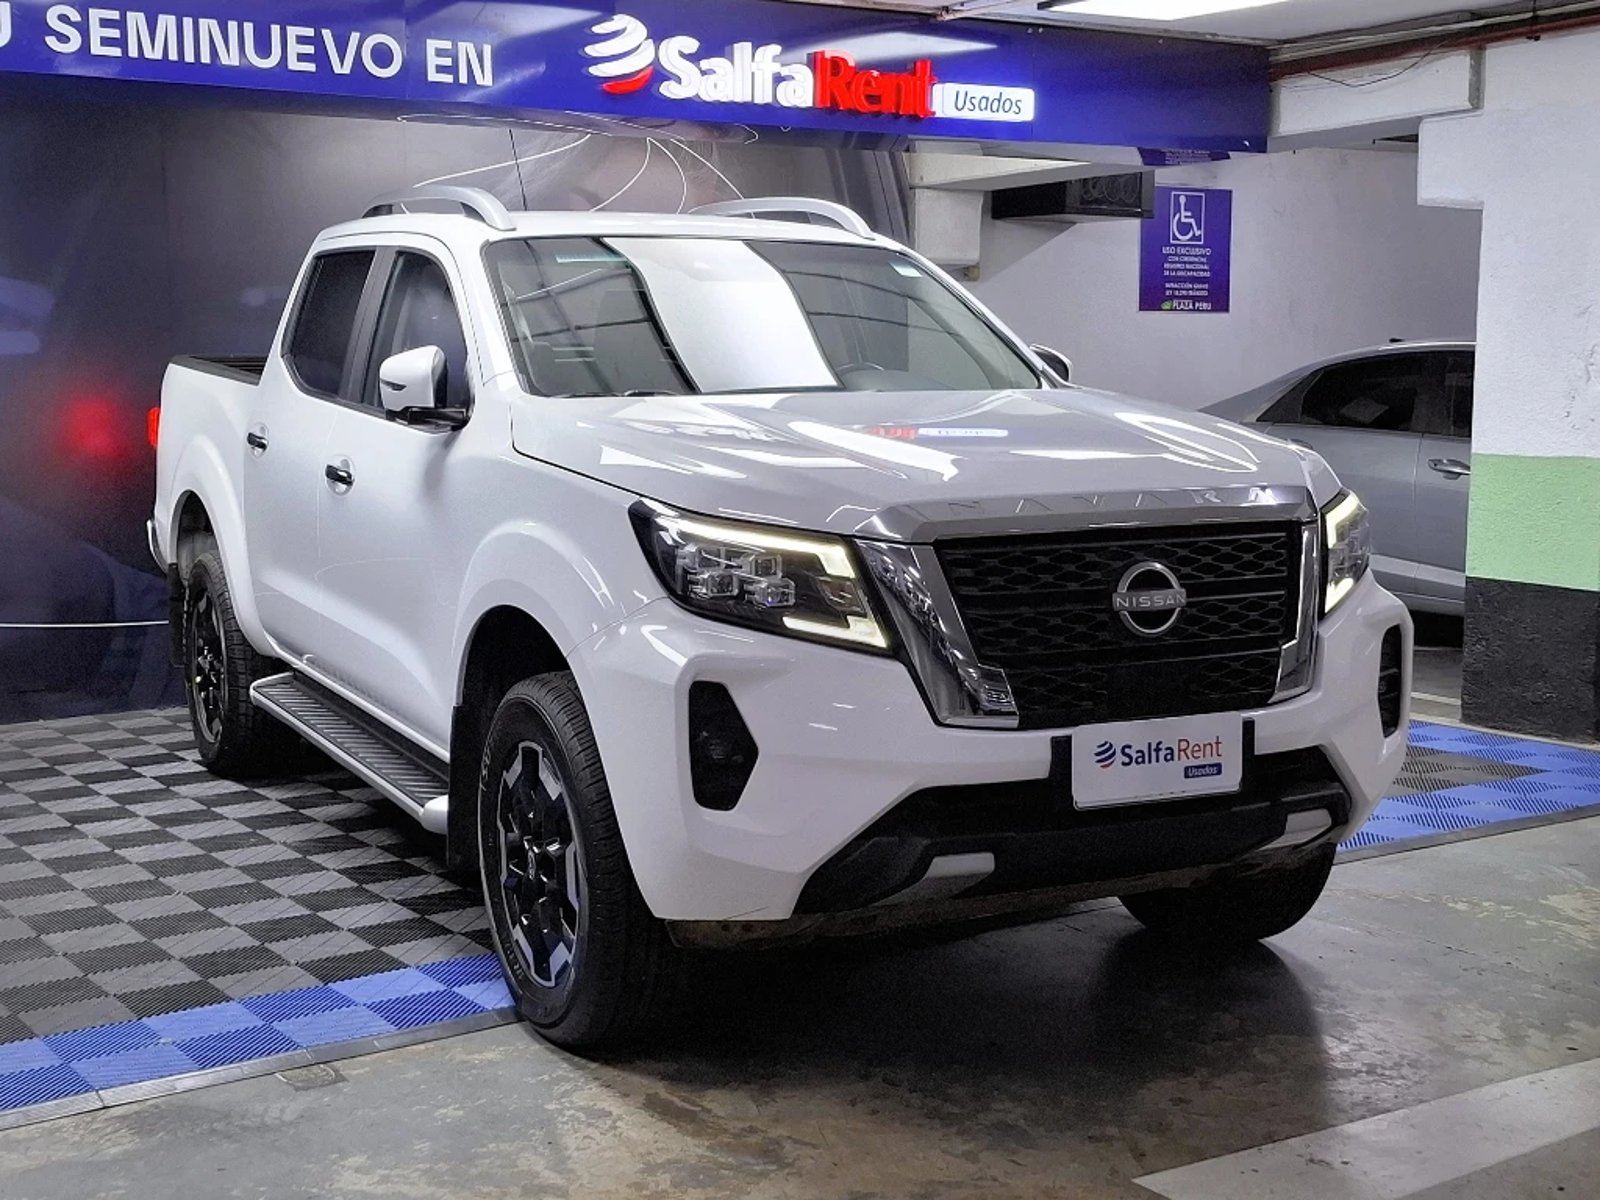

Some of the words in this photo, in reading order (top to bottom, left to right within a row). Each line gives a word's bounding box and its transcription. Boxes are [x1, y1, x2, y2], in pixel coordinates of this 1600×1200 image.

[45, 4, 403, 78] SEMINUEVO
[426, 38, 493, 87] EN
[657, 34, 937, 118] SalfaRent
[953, 89, 1023, 115] Usados
[1173, 300, 1194, 310] PLAZA
[1116, 593, 1186, 608] NISSAN
[1120, 735, 1222, 767] SalfaRent
[1187, 764, 1219, 778] Usados
